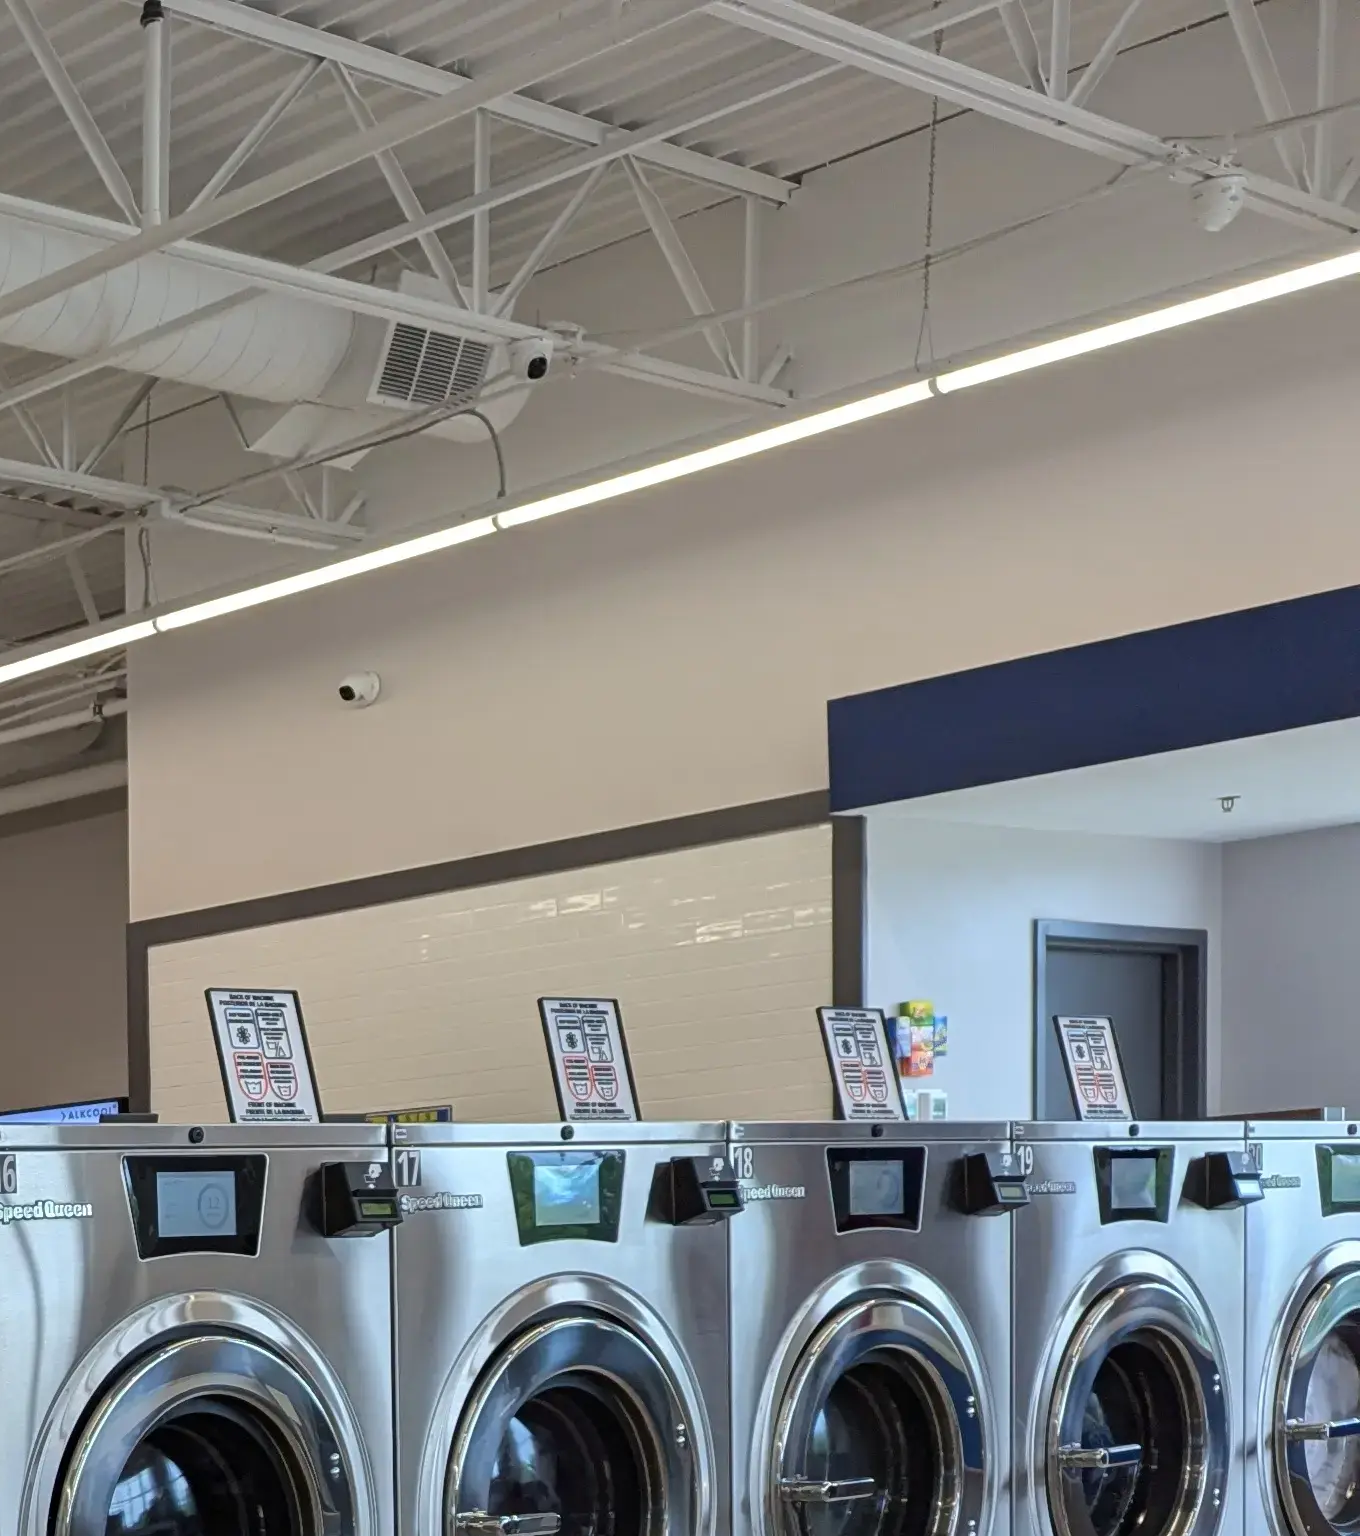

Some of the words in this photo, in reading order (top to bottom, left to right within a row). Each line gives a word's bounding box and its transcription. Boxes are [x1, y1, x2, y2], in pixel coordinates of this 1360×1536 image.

[397, 1151, 420, 1186] 17
[734, 1147, 753, 1178] 18
[1017, 1145, 1033, 1175] 19
[401, 1193, 443, 1214] Speed
[741, 1184, 771, 1202] peed
[43, 1199, 93, 1219] Queen
